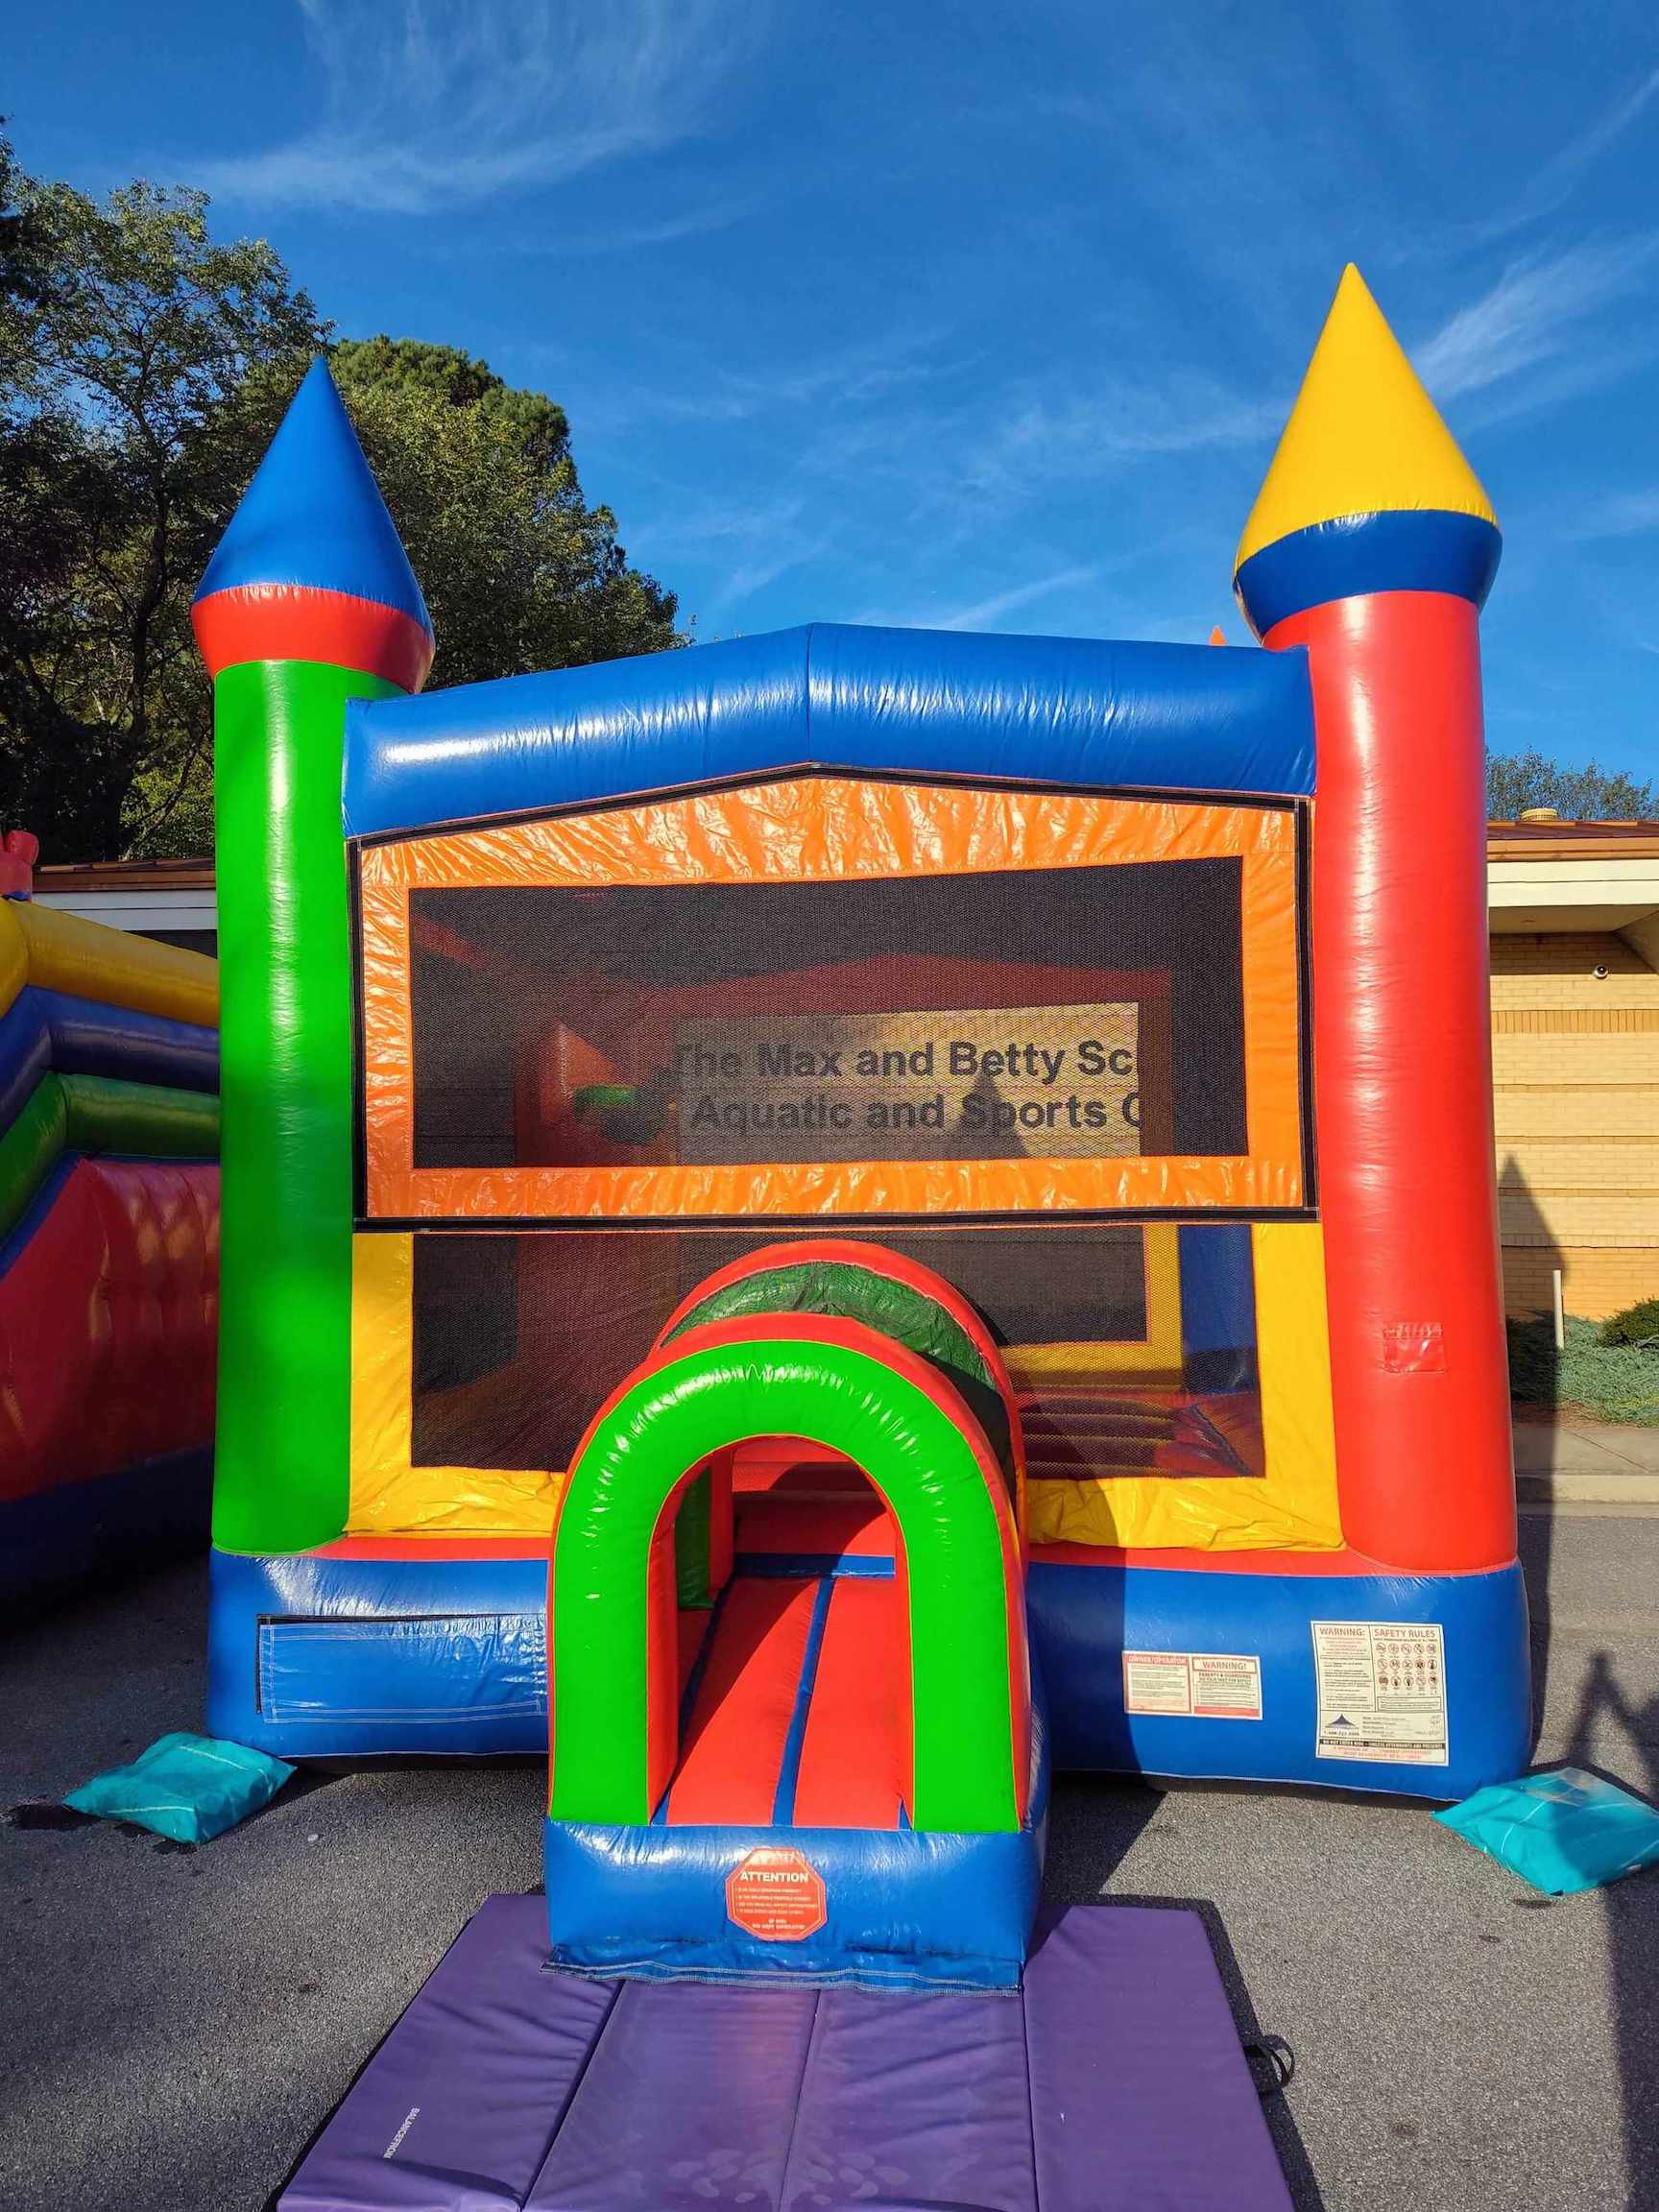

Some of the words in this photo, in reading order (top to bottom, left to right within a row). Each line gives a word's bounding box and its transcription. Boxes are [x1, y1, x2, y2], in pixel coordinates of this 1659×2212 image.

[757, 1043, 842, 1077] Max
[855, 1042, 933, 1076] and
[950, 1041, 1067, 1084] Betty
[691, 1094, 853, 1136] Aquatic
[867, 1094, 944, 1128] and
[962, 1094, 1107, 1138] Sports
[1319, 1627, 1365, 1637] WARNING:
[1374, 1628, 1407, 1638] SAFETY
[1202, 1660, 1247, 1671] WARNING!
[739, 1871, 808, 1883] ATTENTION
